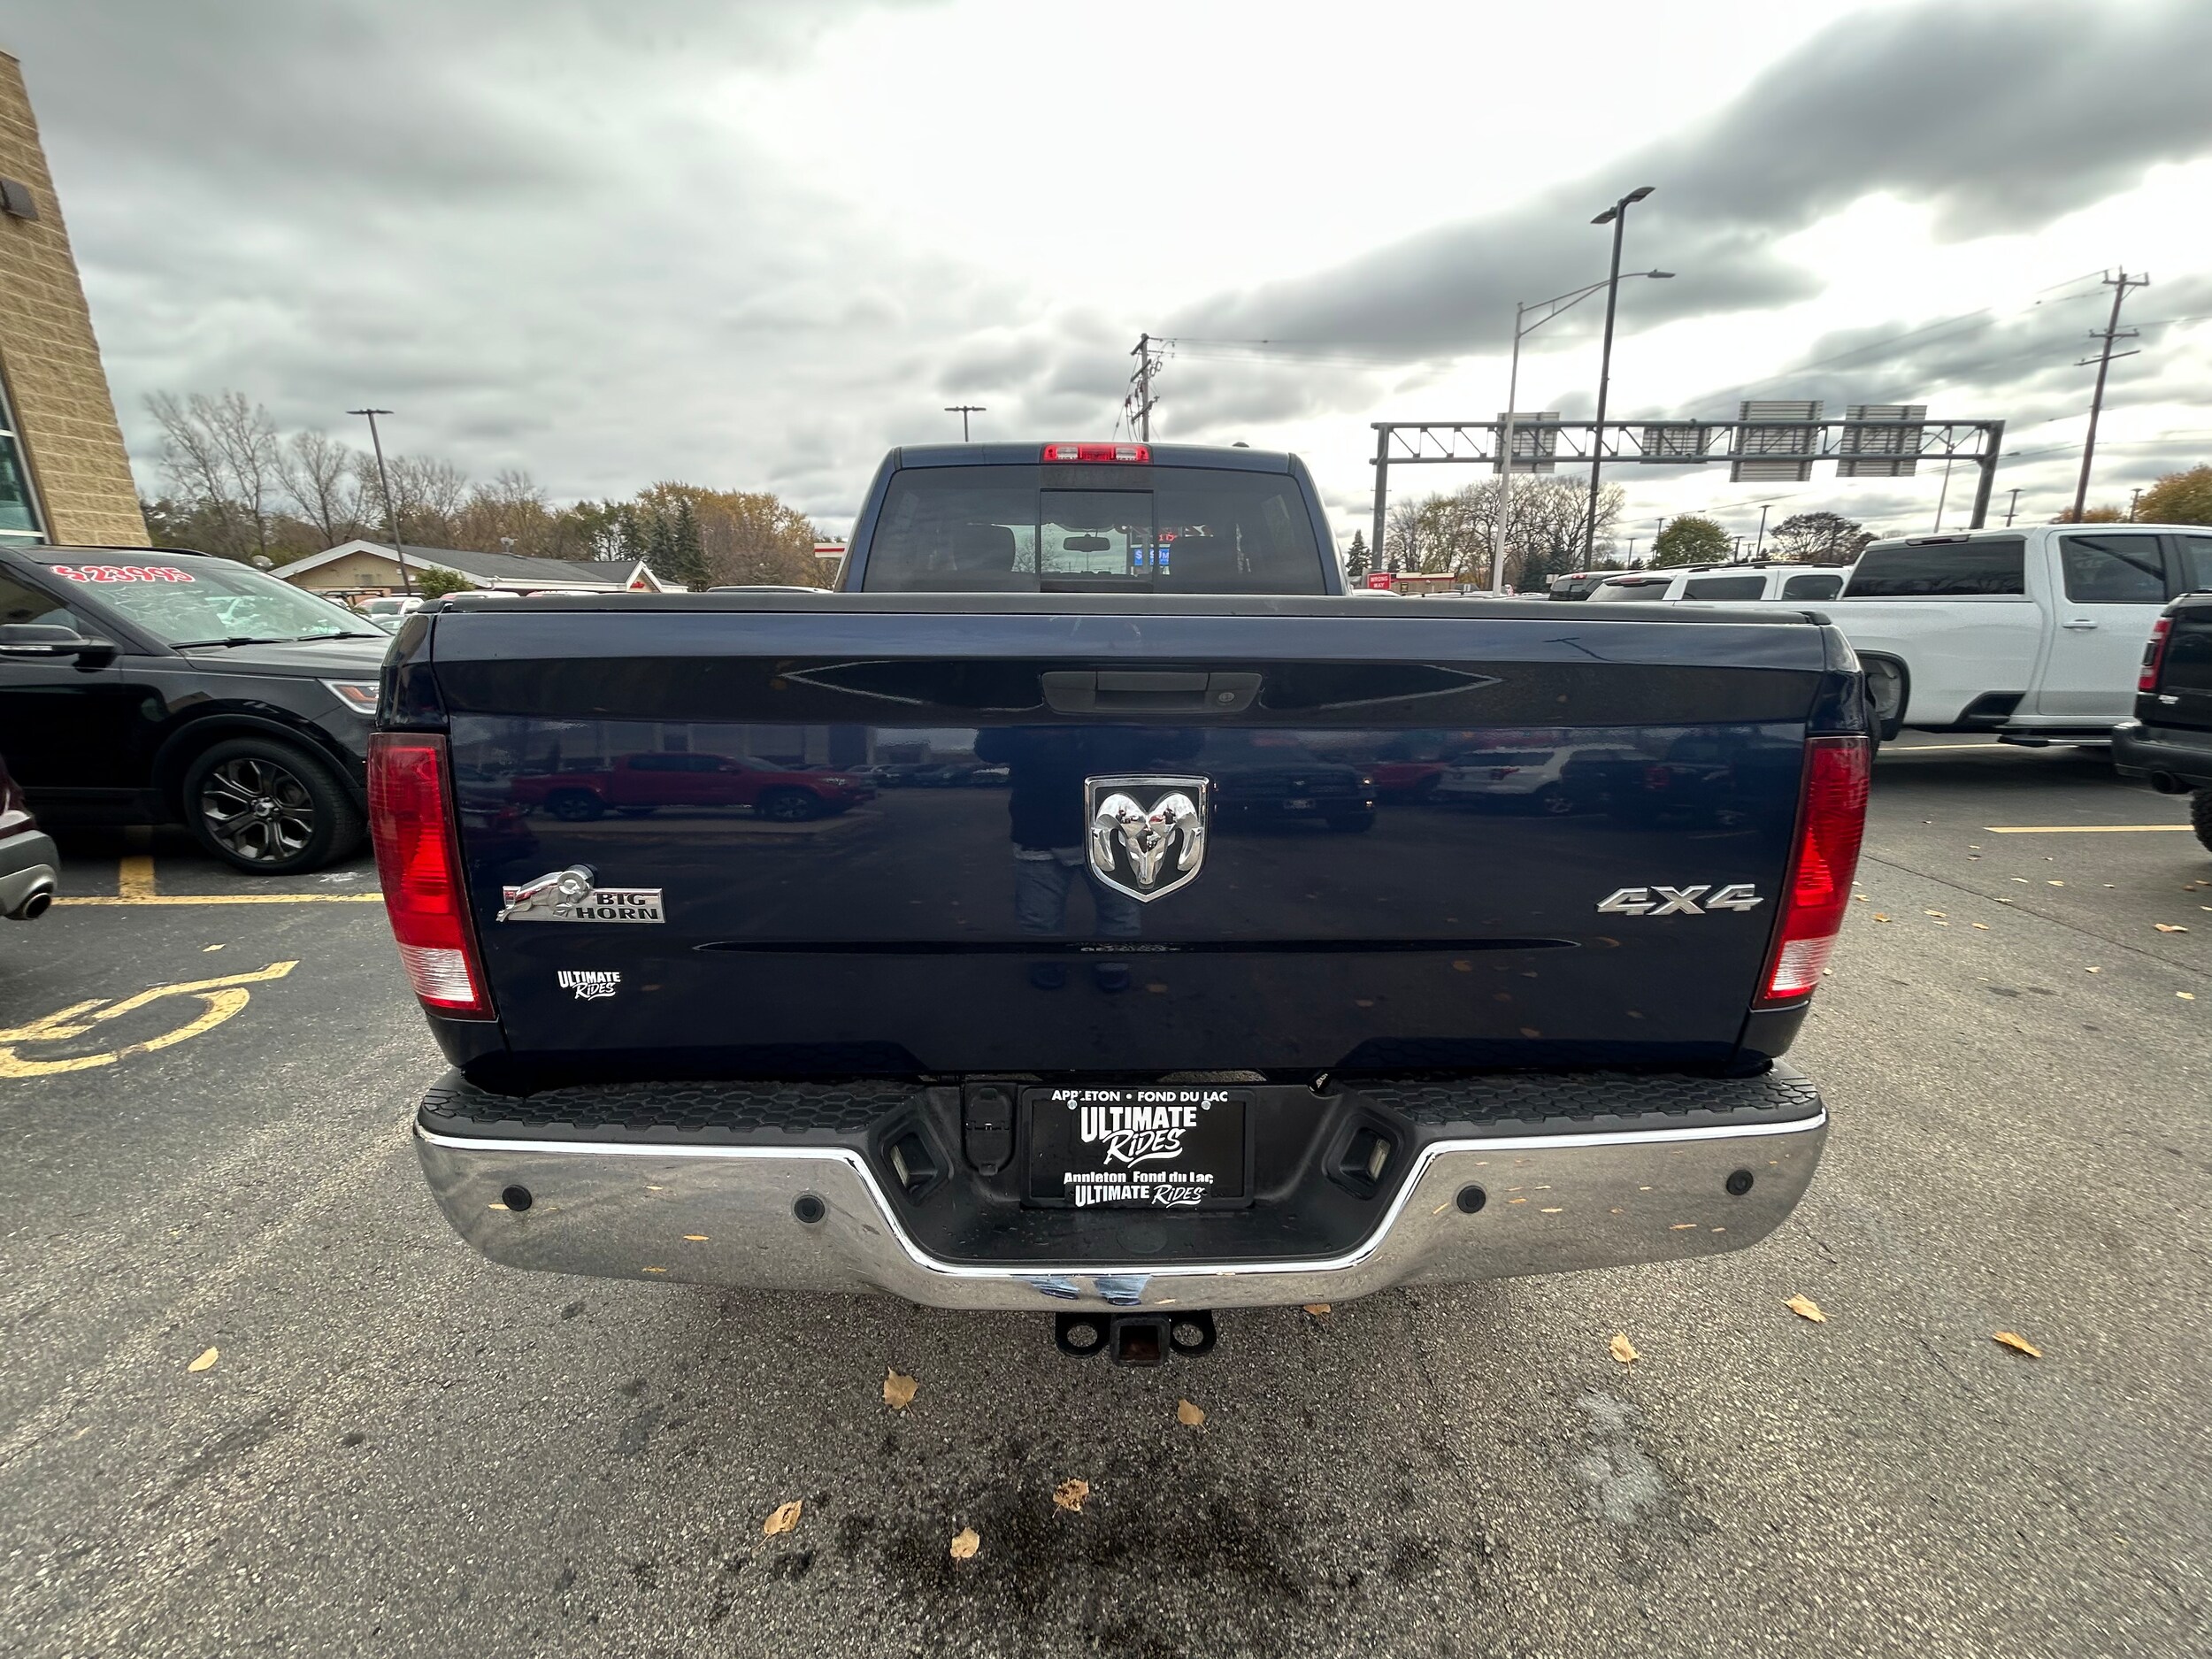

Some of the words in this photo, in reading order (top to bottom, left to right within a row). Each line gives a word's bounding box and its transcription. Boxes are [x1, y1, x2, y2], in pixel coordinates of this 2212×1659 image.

[50, 565, 196, 582] $23995
[596, 893, 646, 905] BIG
[1596, 883, 1764, 916] 4X4
[576, 907, 659, 920] HORN
[557, 971, 621, 988] ULTIMATE
[1137, 1091, 1176, 1102] FOND
[1179, 1091, 1200, 1102] DU
[1203, 1091, 1228, 1102] LAC
[1080, 1106, 1197, 1143] ULTIMATE
[1133, 1171, 1166, 1183] Fond
[1169, 1171, 1187, 1183] du
[1189, 1171, 1214, 1184] Lac
[1075, 1185, 1150, 1207] ULTIMATE
